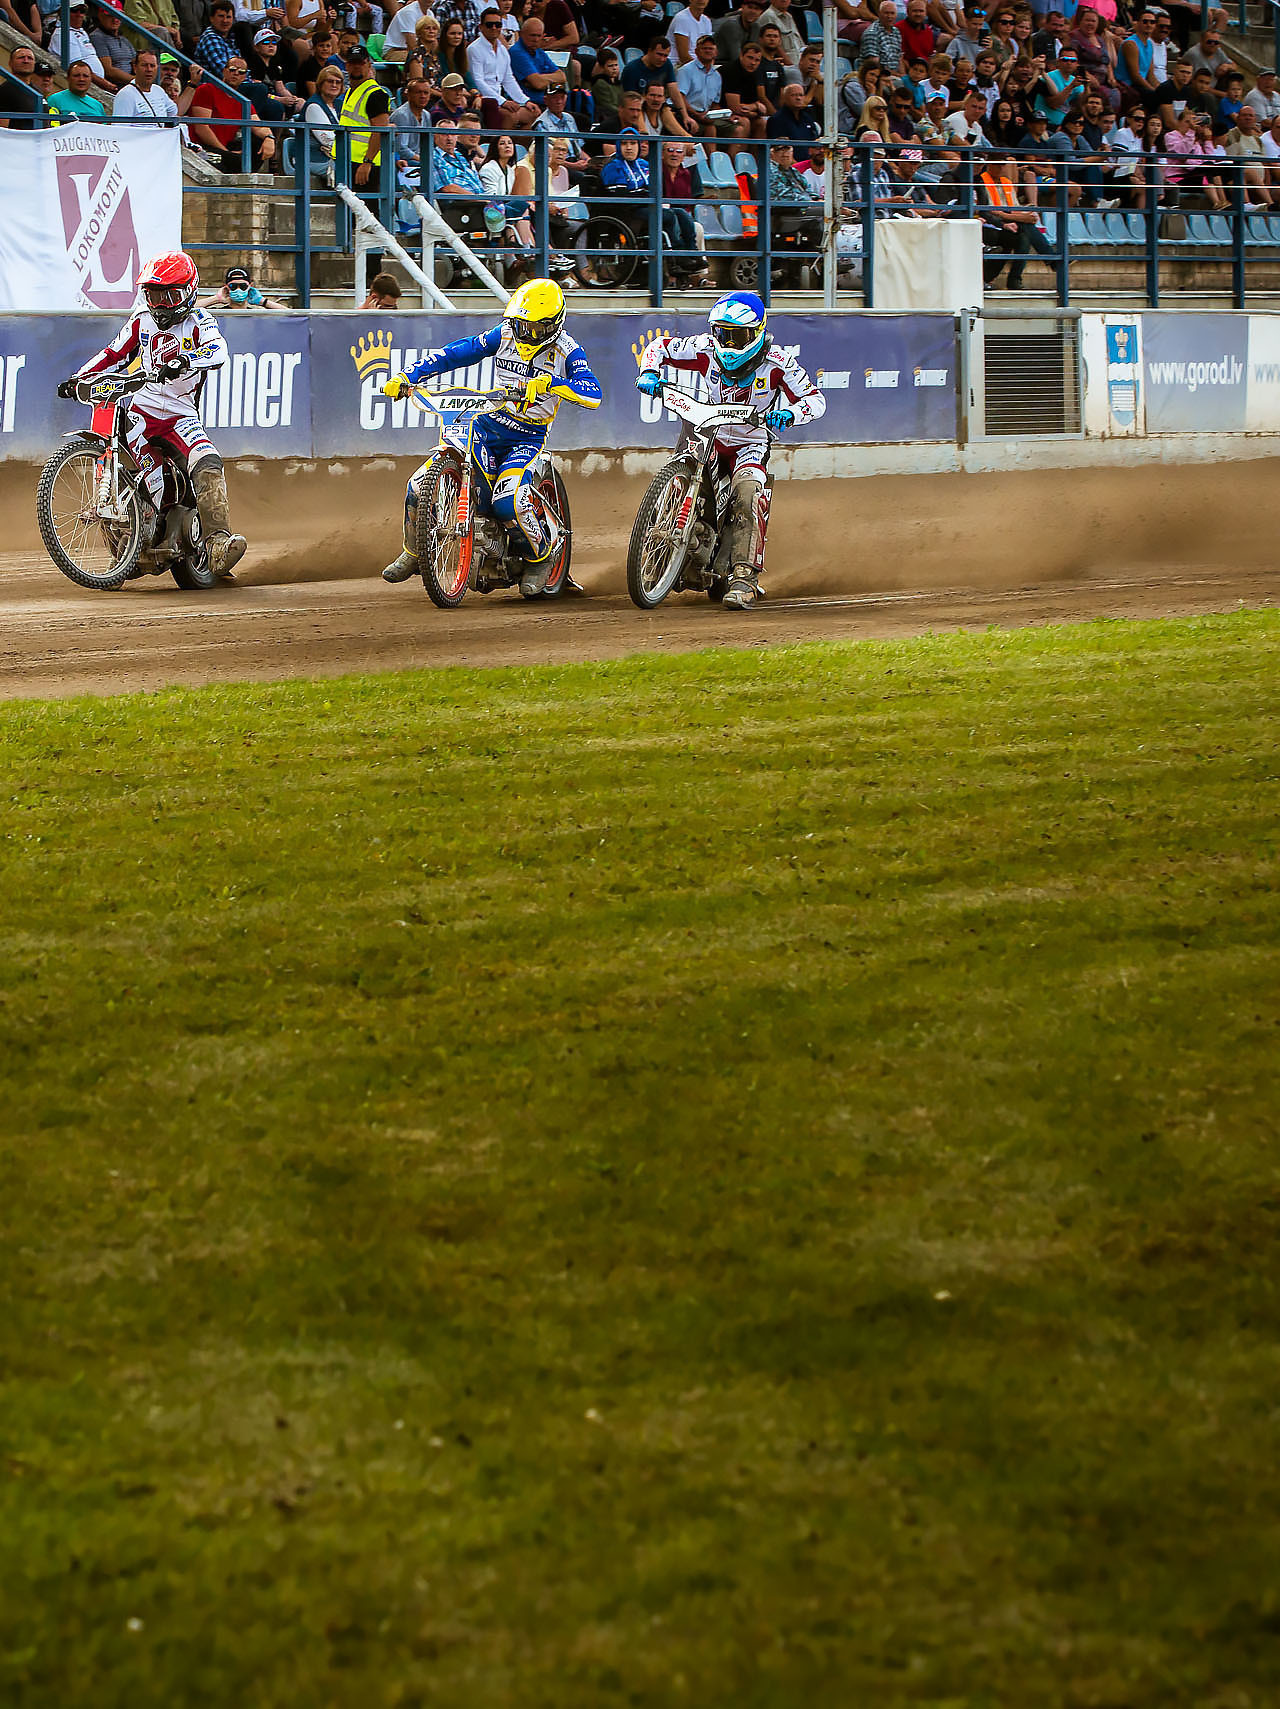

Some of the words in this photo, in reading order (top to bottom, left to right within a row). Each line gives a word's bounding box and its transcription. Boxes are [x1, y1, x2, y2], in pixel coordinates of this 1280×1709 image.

[53, 136, 121, 153] DAUGAVPILS
[72, 163, 124, 273] LOKOMOTIV
[1148, 354, 1244, 393] www.gorod.lv
[439, 398, 487, 409] LAVOR
[444, 425, 468, 435] FST
